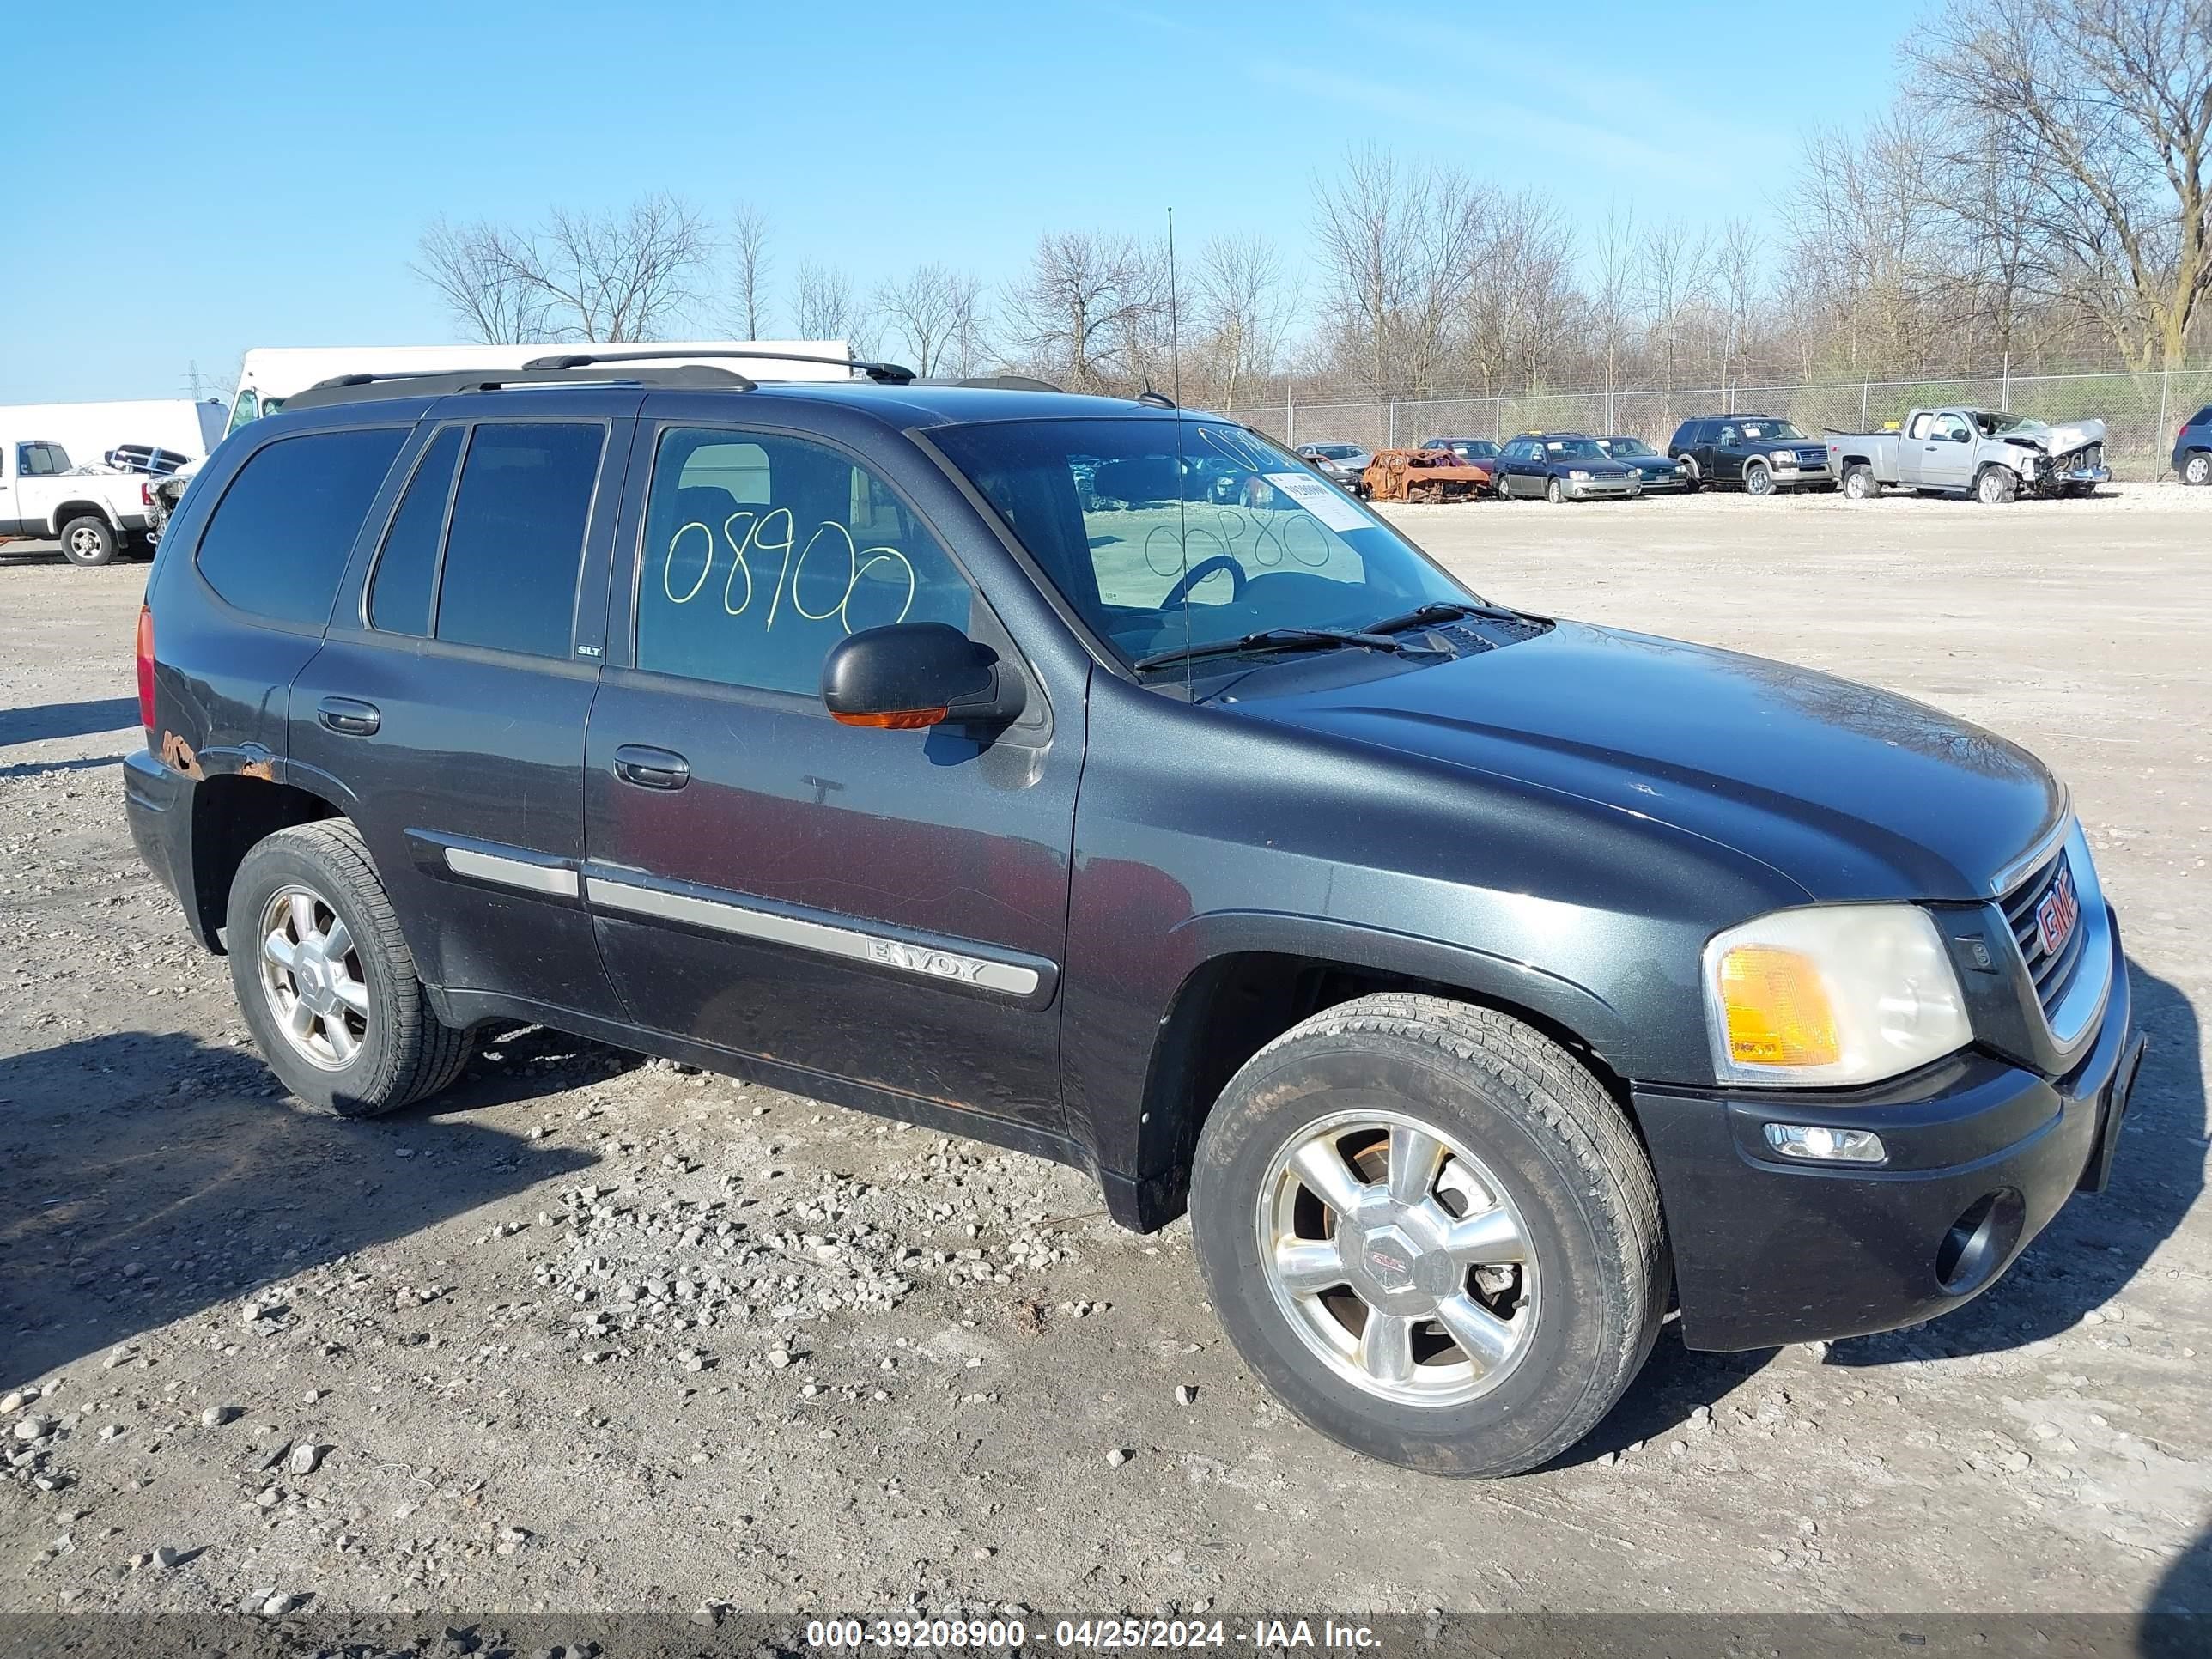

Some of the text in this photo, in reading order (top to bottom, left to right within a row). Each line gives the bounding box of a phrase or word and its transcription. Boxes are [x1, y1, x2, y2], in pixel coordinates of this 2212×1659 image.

[665, 507, 915, 634] 08900
[577, 645, 601, 657] SLT
[867, 938, 986, 982] ENVOY
